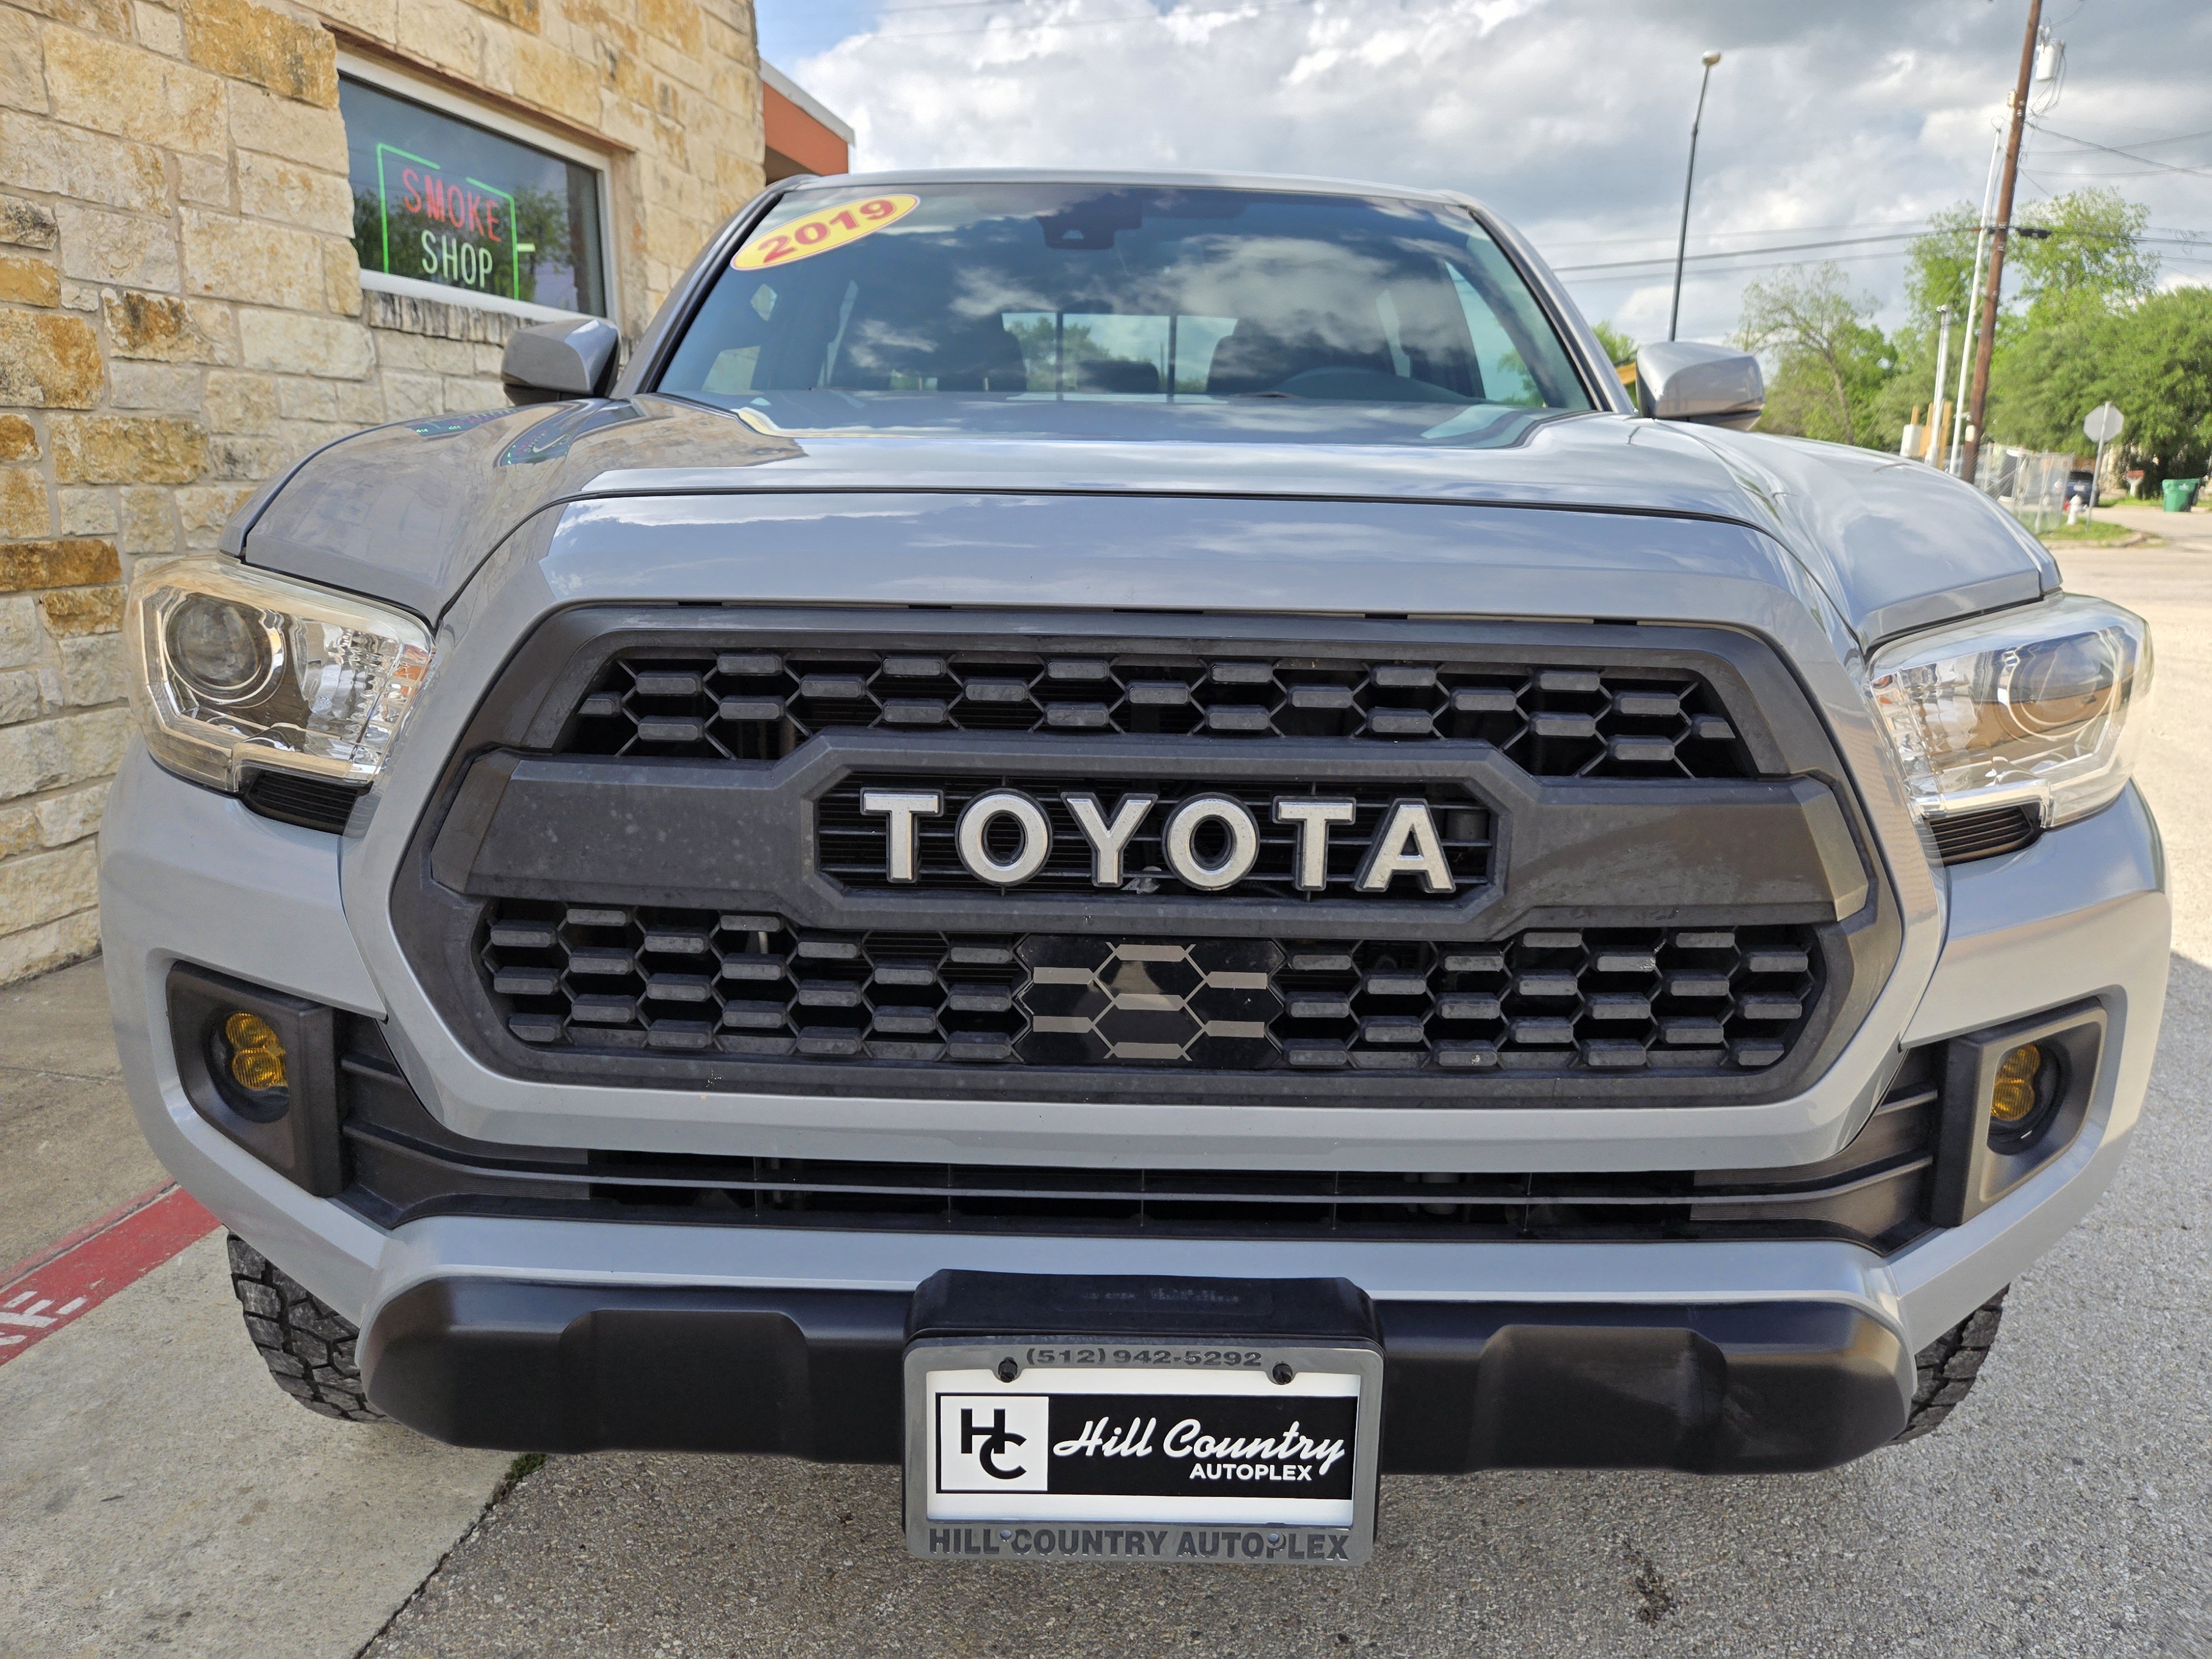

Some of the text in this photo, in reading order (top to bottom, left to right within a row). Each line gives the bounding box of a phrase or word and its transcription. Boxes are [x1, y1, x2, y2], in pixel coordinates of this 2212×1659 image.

[402, 168, 502, 242] SMOKE
[757, 199, 897, 263] 2019
[421, 229, 493, 289] SHOP
[861, 789, 1456, 893] TOYOTA
[1053, 1416, 1345, 1476] Hill Country
[1189, 1463, 1313, 1481] AUTOPLEX
[929, 1528, 1350, 1562] HILL COUNTRY AUTOPLEX
